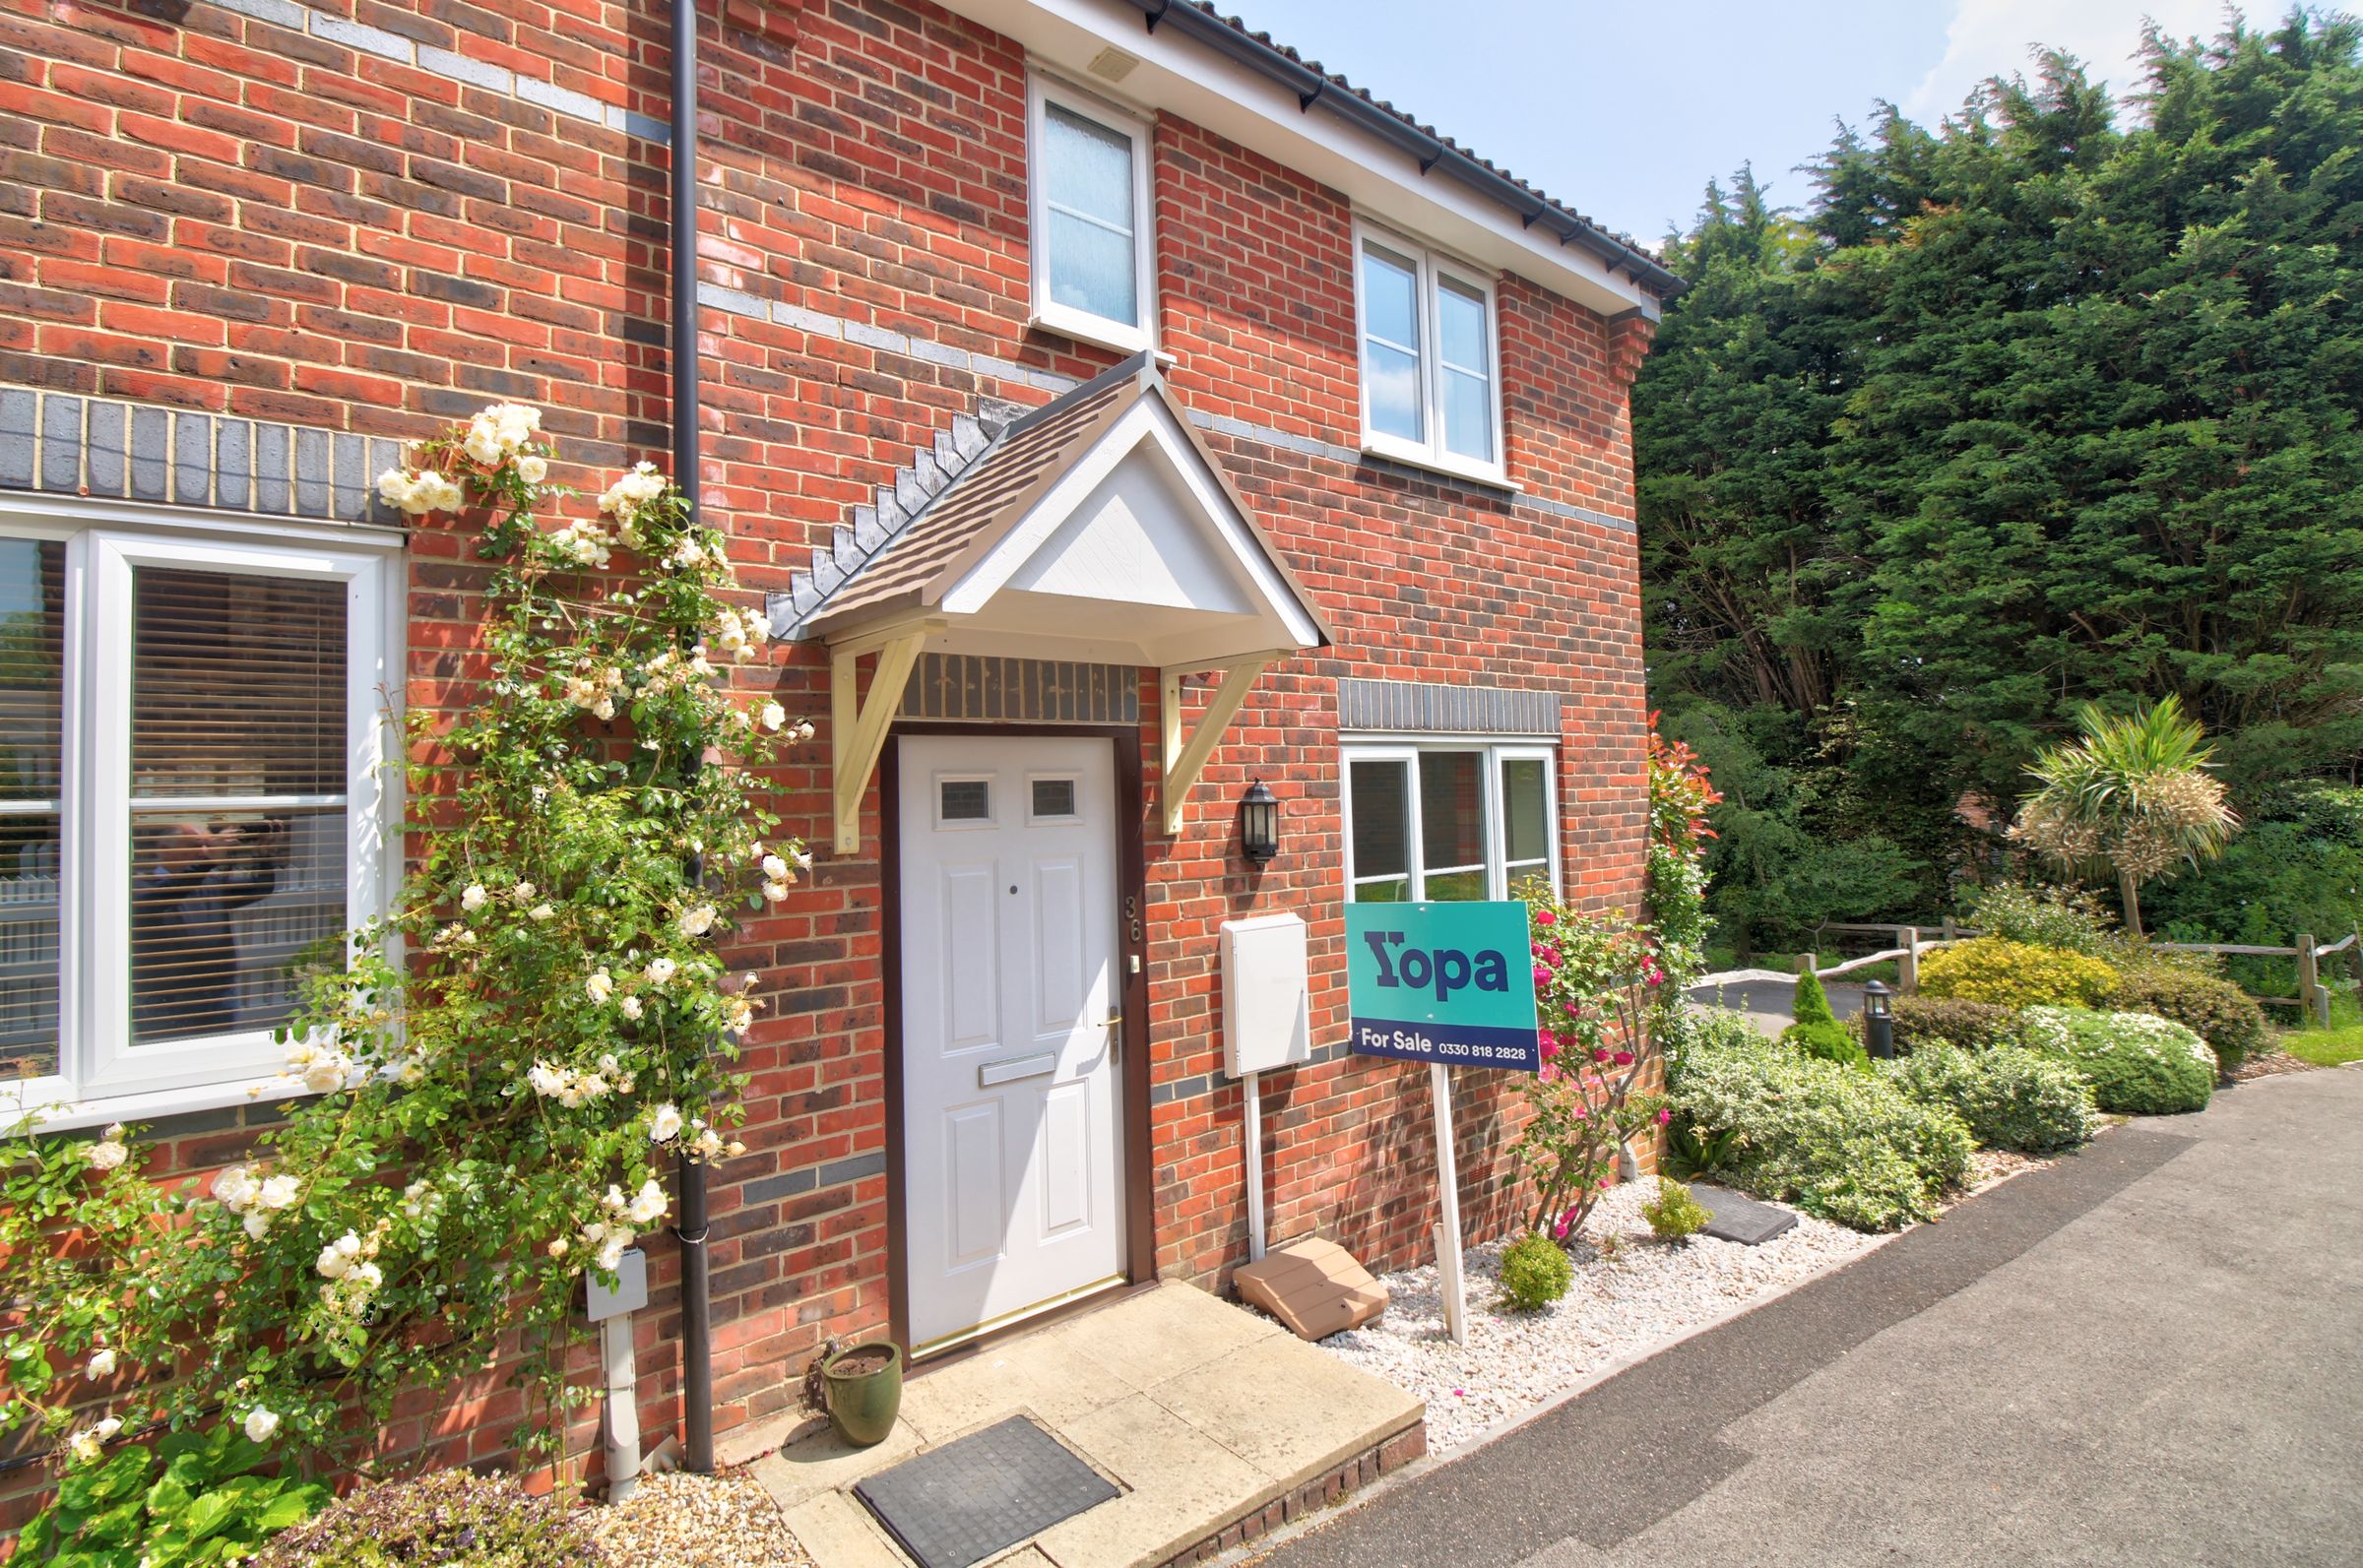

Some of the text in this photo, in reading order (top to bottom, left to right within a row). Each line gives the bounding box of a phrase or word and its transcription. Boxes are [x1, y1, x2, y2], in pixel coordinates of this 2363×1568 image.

[1125, 896, 1140, 941] 36
[1364, 931, 1509, 1002] Yopa
[1362, 1028, 1526, 1060] For Sale 0330 818 2828
